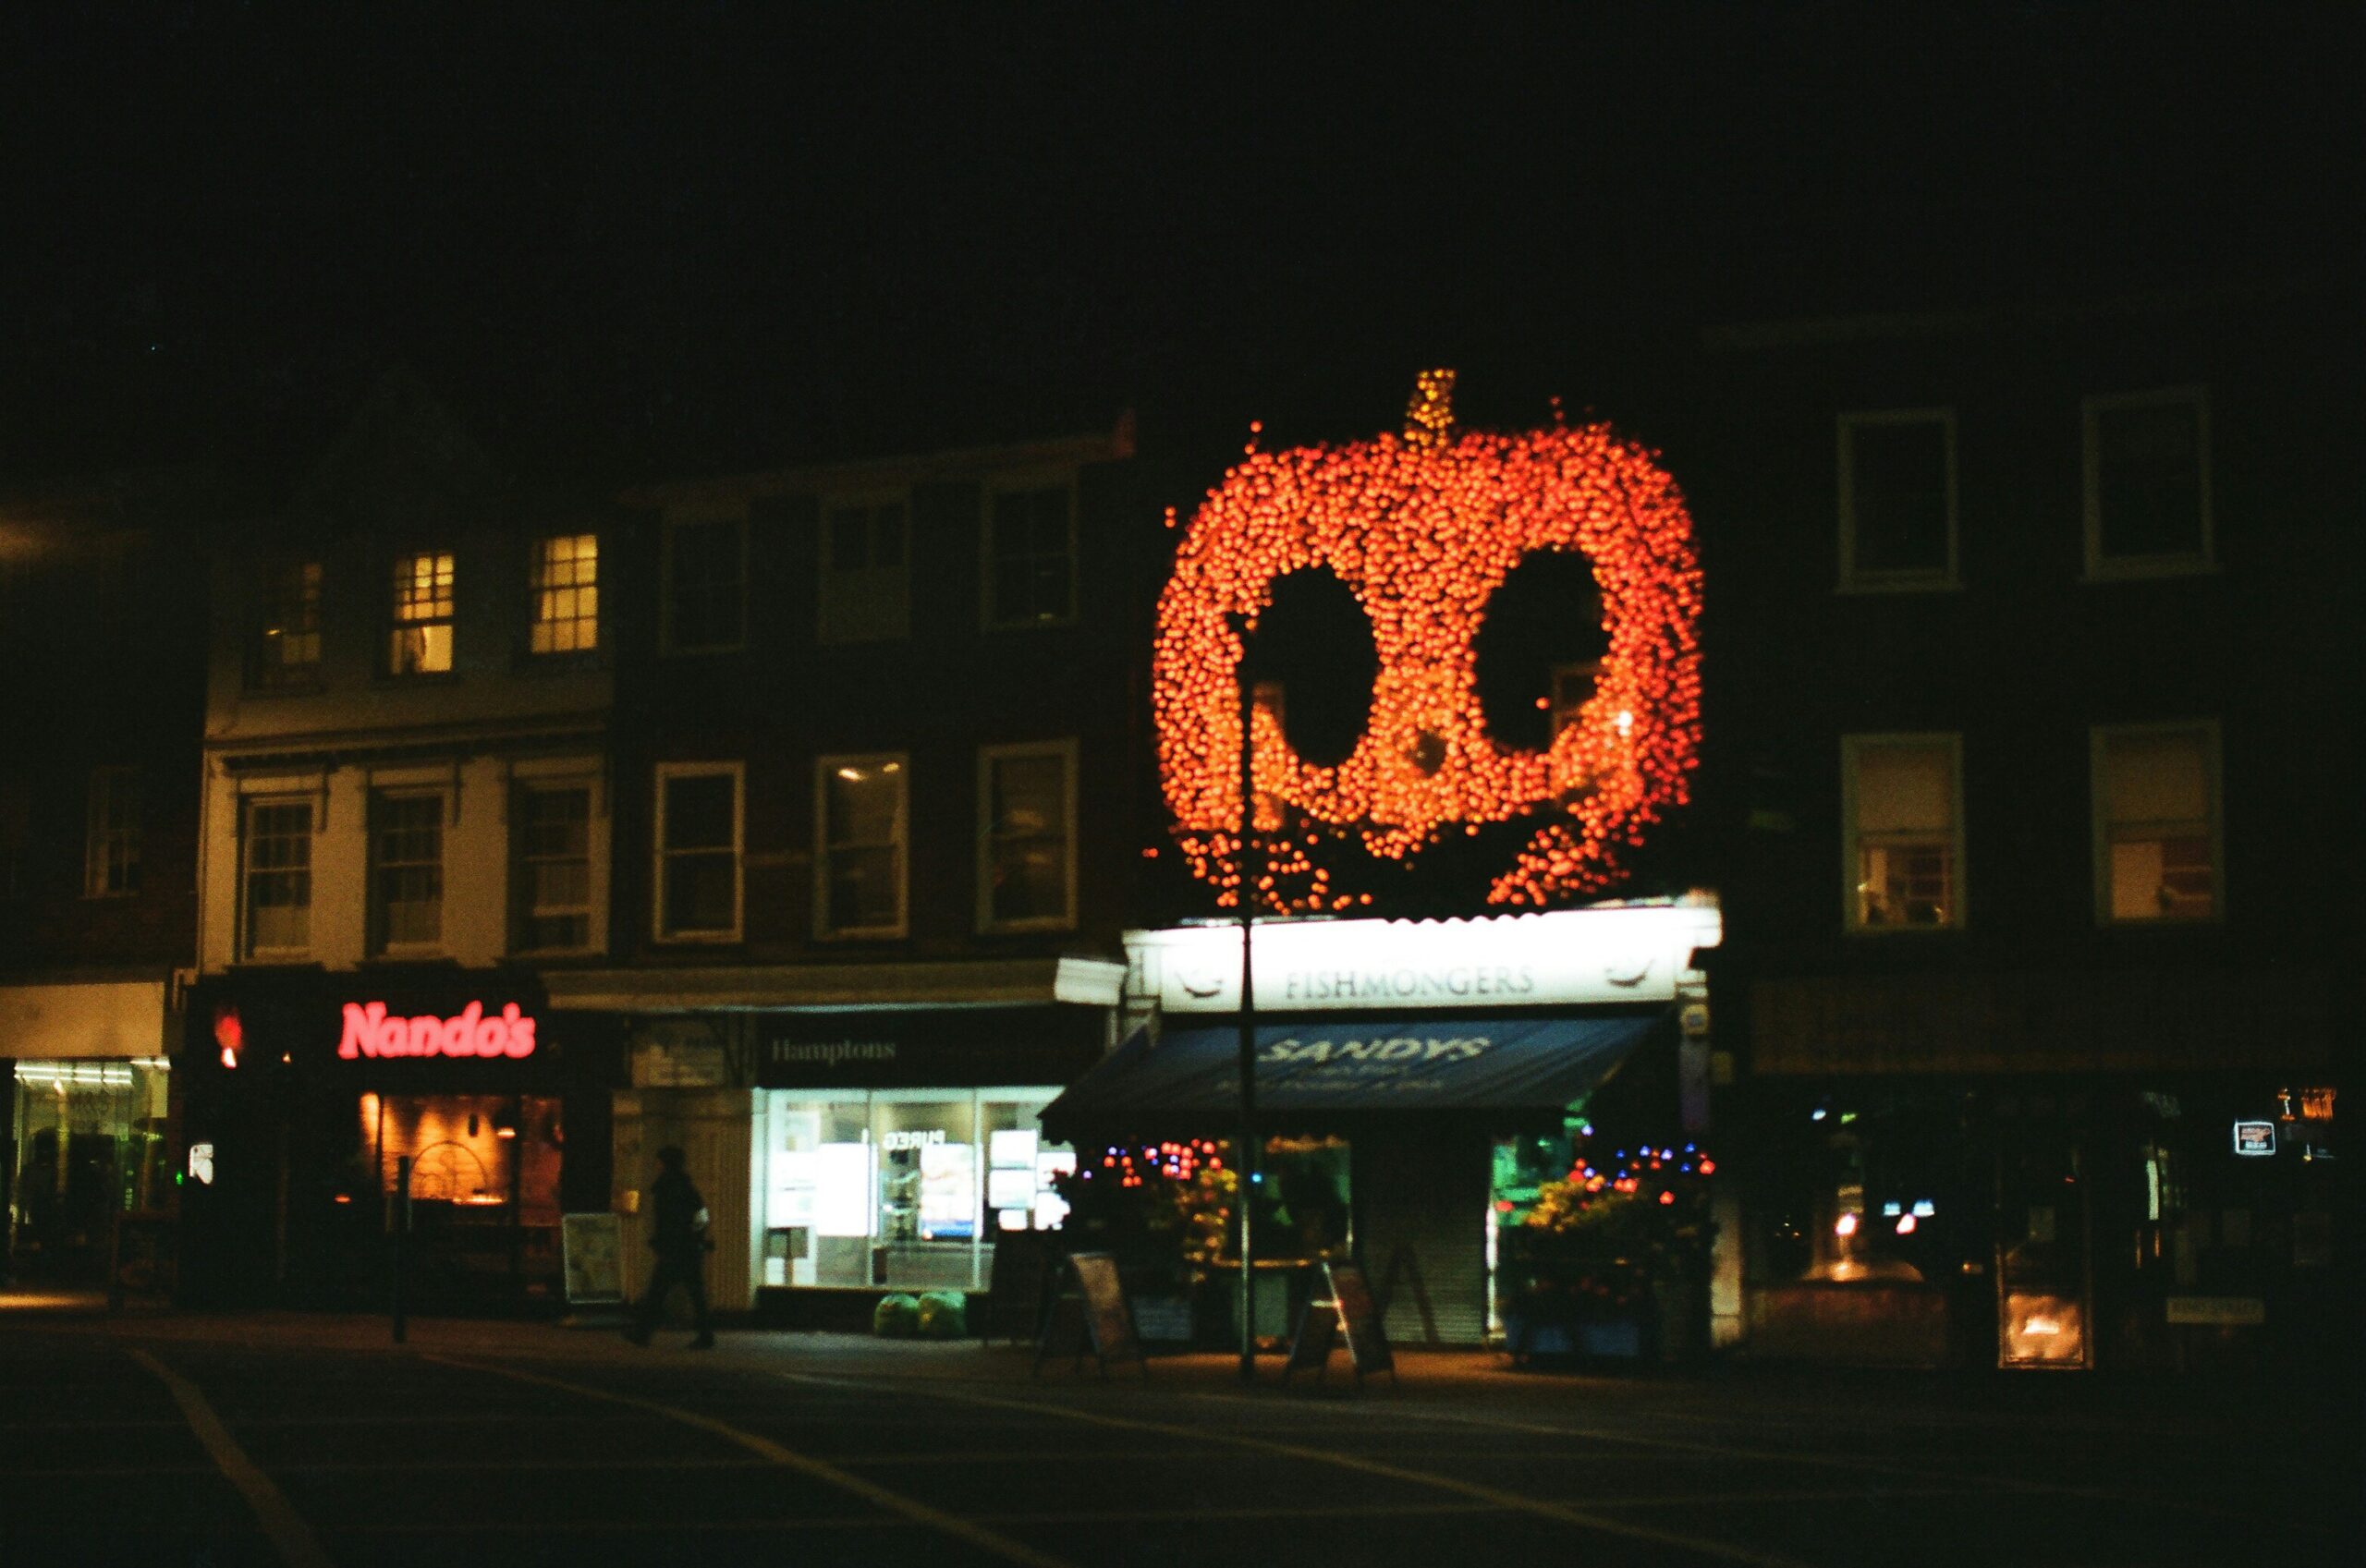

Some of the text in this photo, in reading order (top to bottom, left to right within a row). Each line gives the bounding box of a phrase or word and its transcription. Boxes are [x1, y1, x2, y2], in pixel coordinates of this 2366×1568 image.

[1286, 966, 1535, 999] FISHMONGERS
[337, 1000, 536, 1060] Nando's
[771, 1039, 896, 1067] Hamptons
